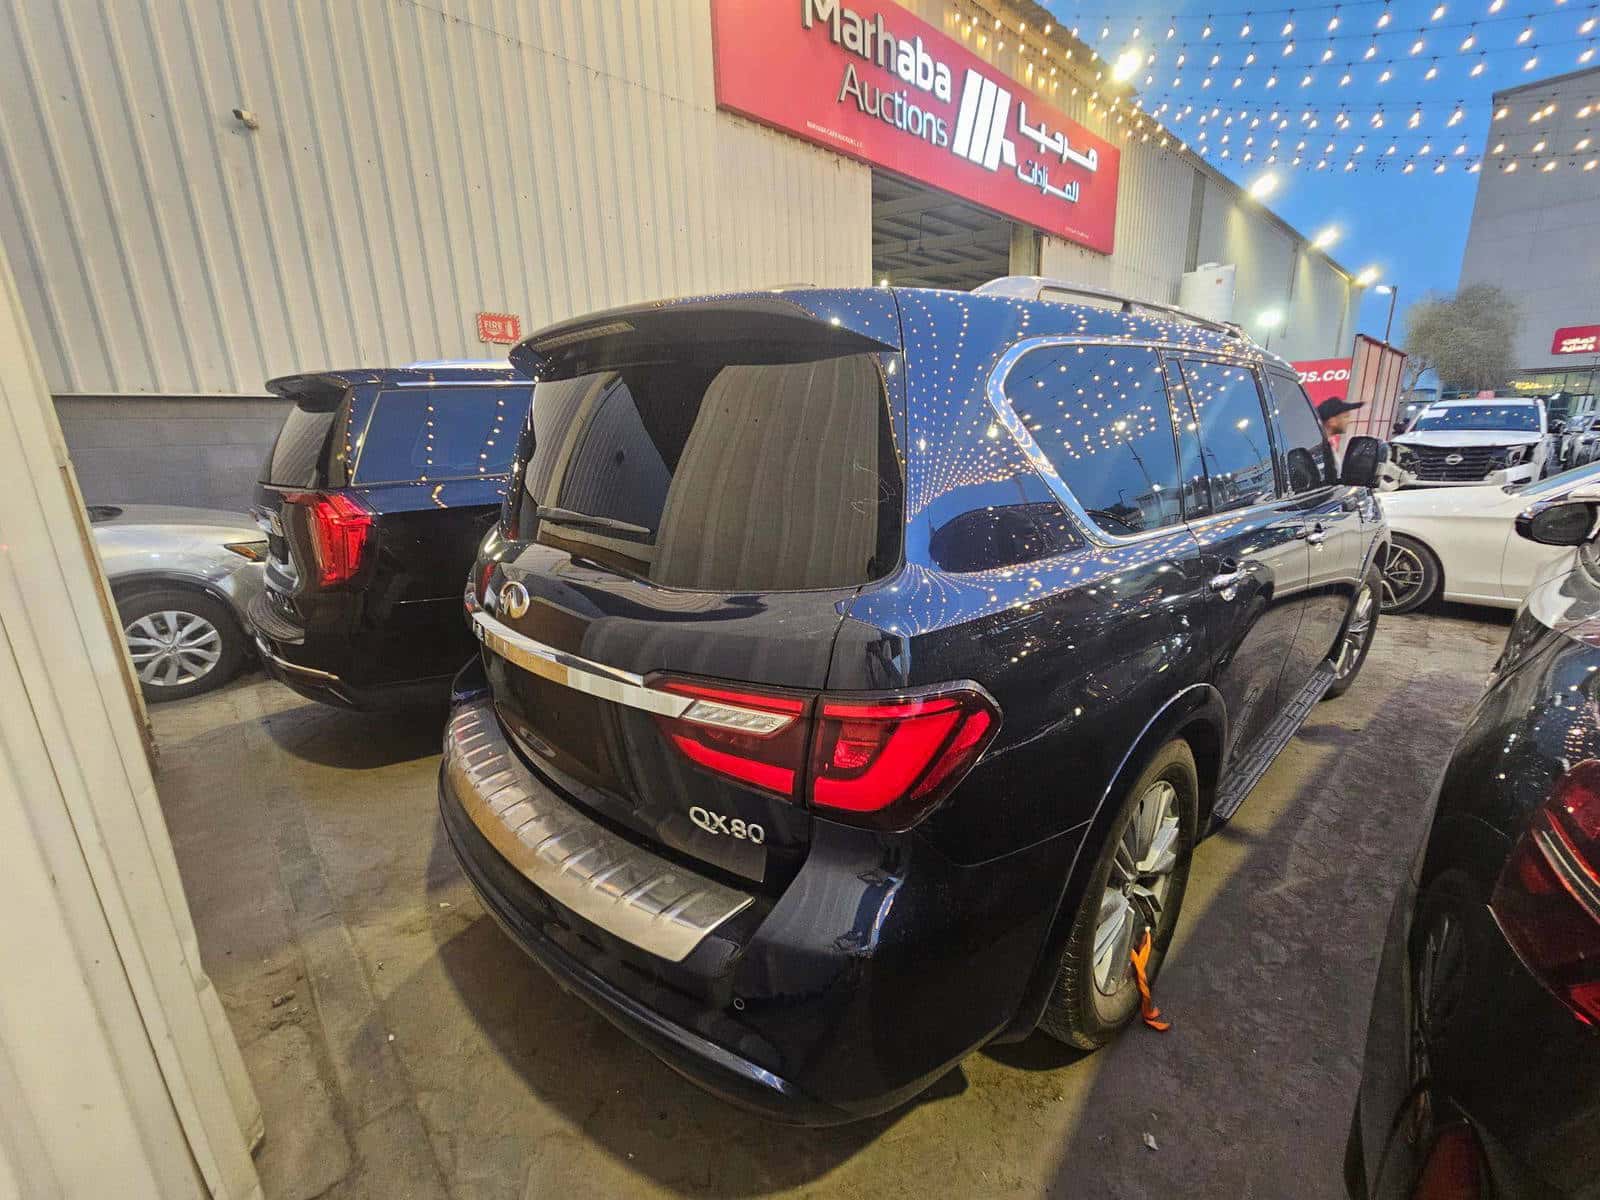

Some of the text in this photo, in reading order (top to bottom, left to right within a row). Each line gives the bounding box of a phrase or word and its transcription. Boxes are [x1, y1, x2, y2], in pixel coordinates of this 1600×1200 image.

[802, 0, 952, 103] Marhaba
[839, 63, 948, 146] Auctions
[1019, 101, 1098, 172] مرحبا
[689, 806, 765, 844] QX80
